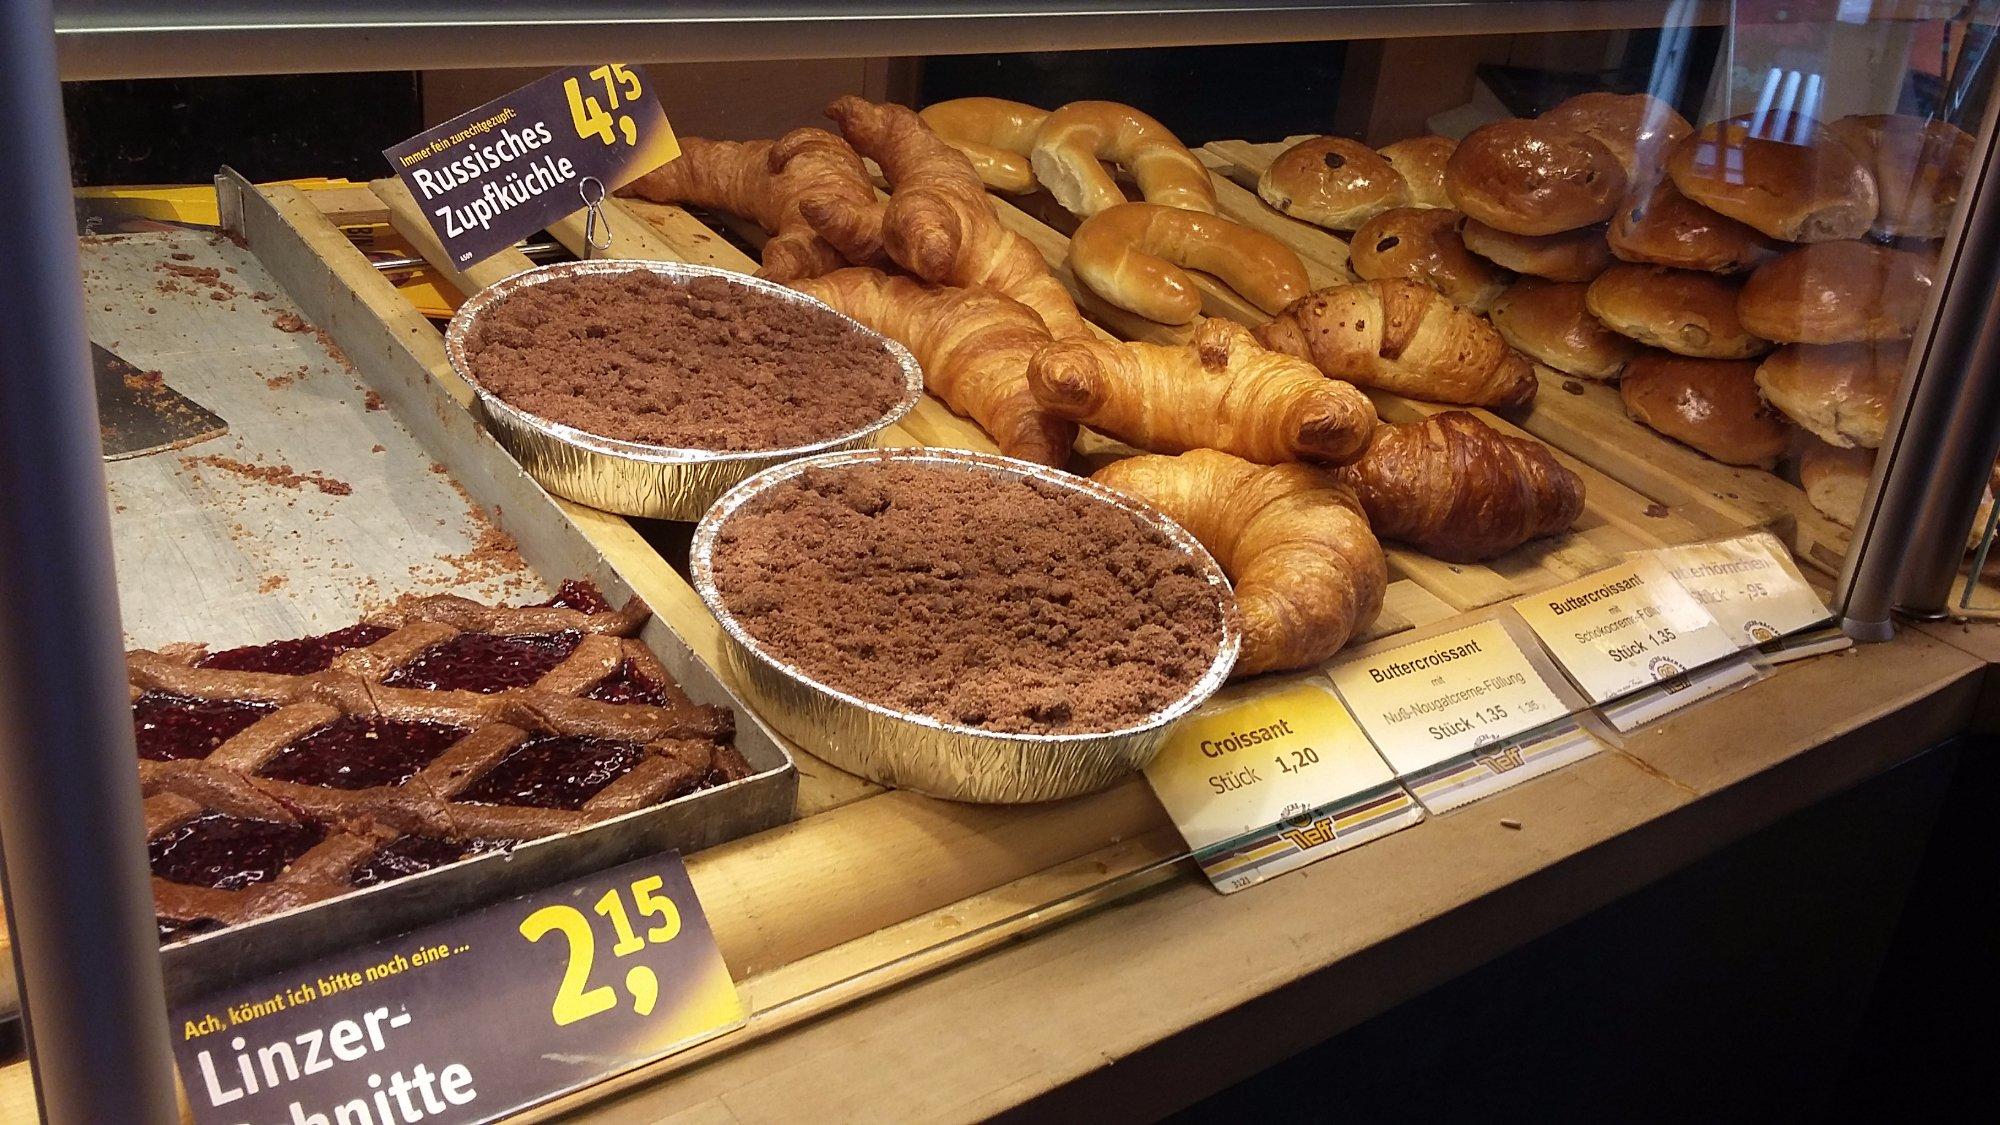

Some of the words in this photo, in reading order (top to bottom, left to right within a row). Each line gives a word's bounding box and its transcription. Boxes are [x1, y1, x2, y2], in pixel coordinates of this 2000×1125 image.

[400, 149, 431, 168] Immer
[430, 138, 451, 154] fein
[449, 108, 517, 145] zurechtgezupft:
[412, 121, 553, 200] Russisches
[435, 155, 577, 239] Zupfküchle
[1549, 573, 1644, 616] Buttercroissant
[1369, 639, 1482, 684] Buttercroissant
[1608, 640, 1649, 662] Stück
[1648, 628, 1677, 647] 1.35
[1382, 672, 1526, 726] Nuß-Nougatcreme-Füllung
[1431, 676, 1446, 687] mit
[1200, 719, 1294, 759] Croissant
[1428, 716, 1476, 741] Stück
[1475, 704, 1508, 725] 1.35
[1208, 766, 1262, 795] Stück
[1275, 747, 1319, 774] 1,20
[519, 875, 682, 1026] 2,15
[184, 1014, 227, 1041] Ach,
[228, 993, 286, 1026] könnt
[286, 984, 317, 1007] ich
[318, 971, 363, 998] bitte
[365, 955, 409, 982] noch
[412, 943, 450, 968] eine
[198, 1006, 412, 1107] Linzer-
